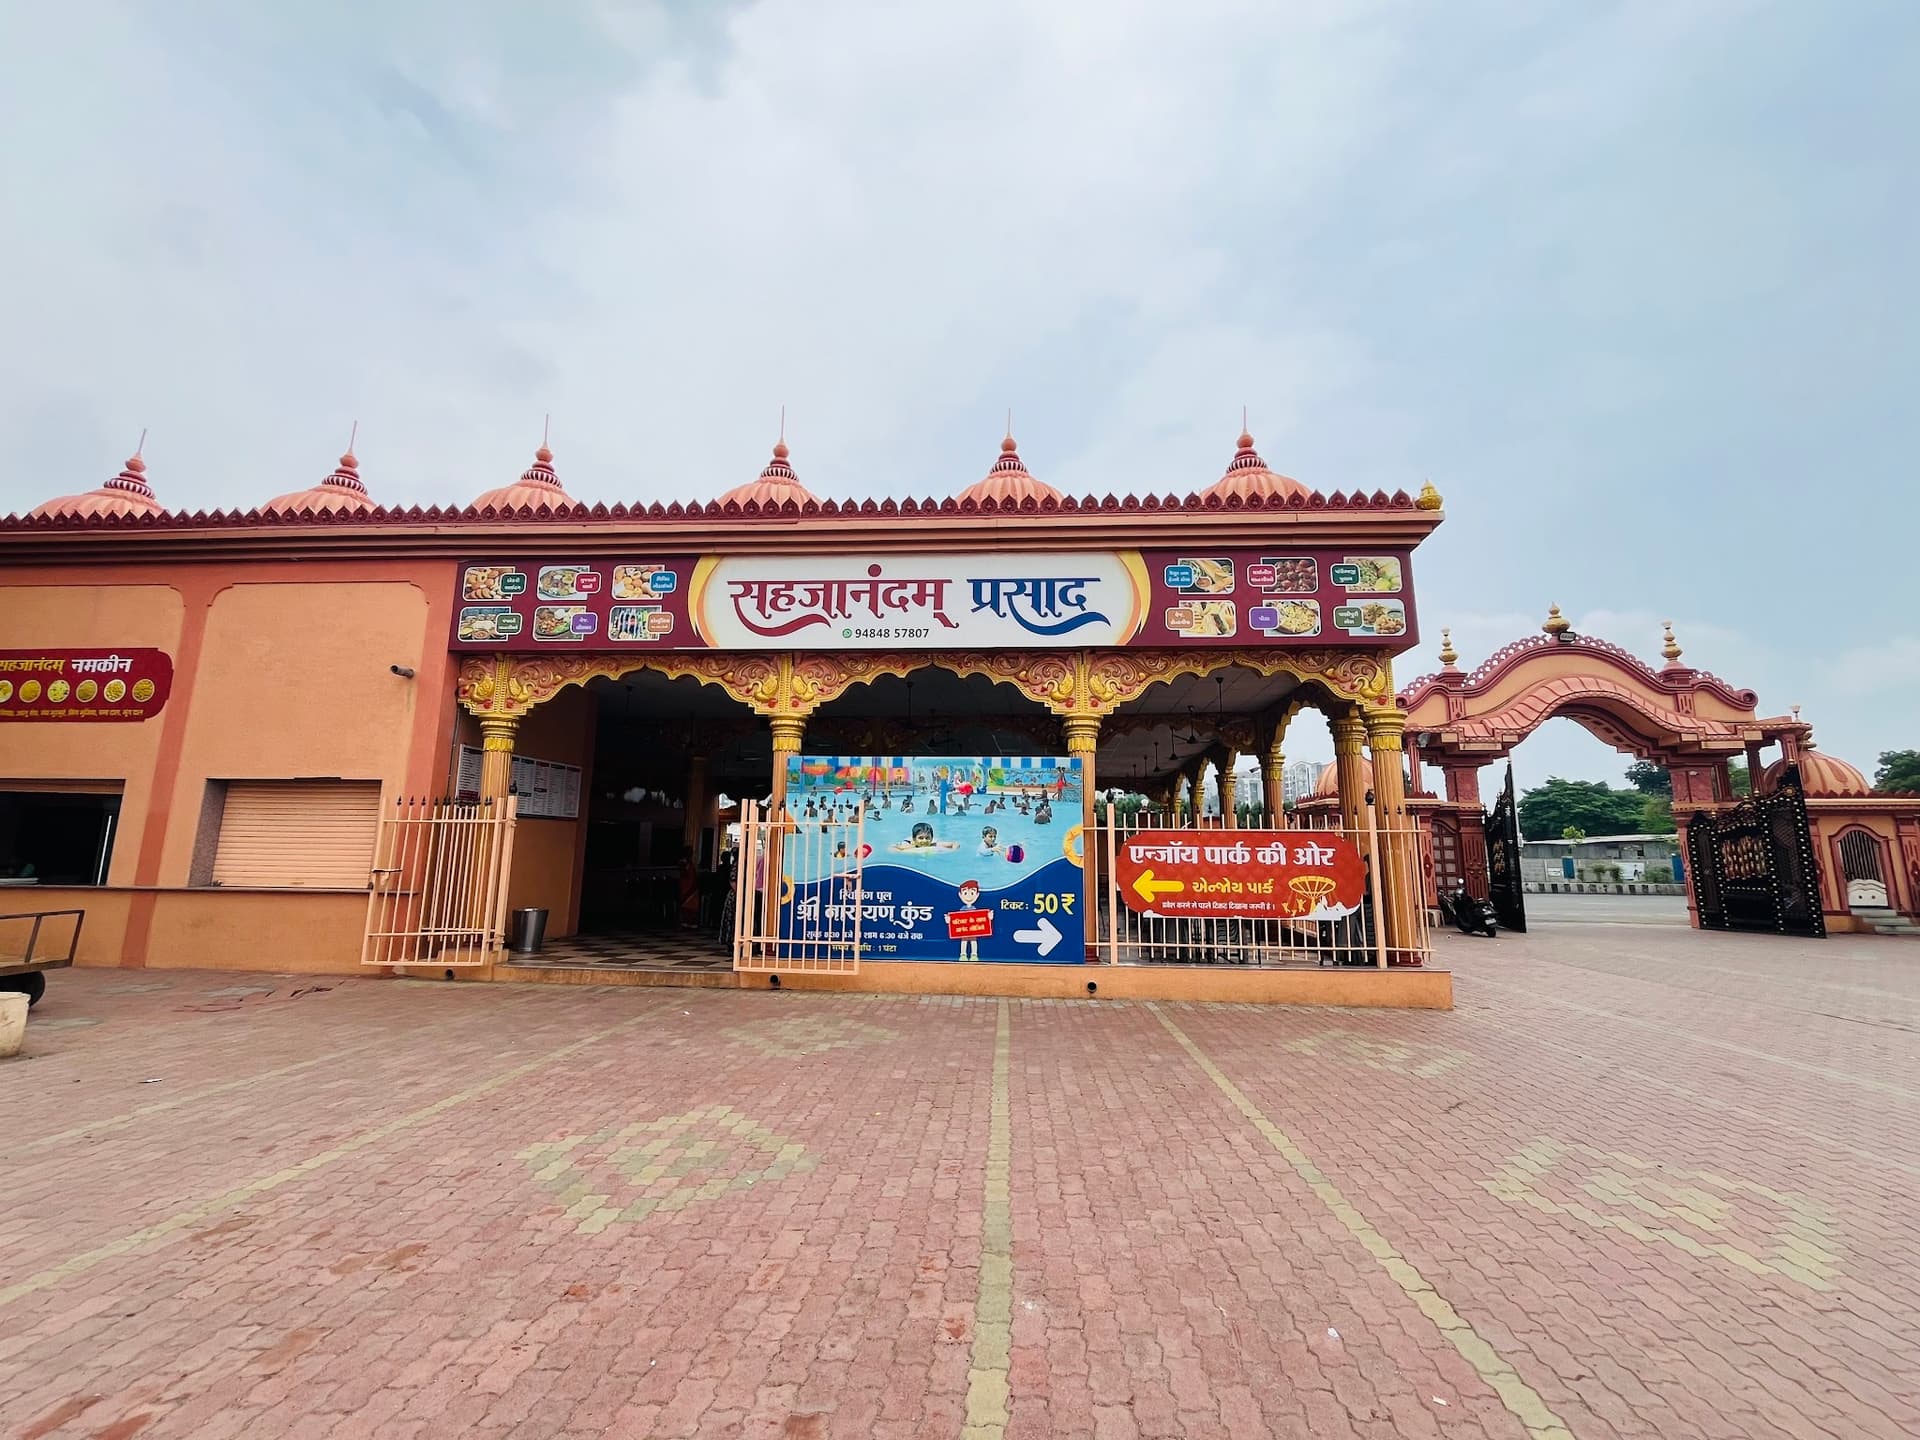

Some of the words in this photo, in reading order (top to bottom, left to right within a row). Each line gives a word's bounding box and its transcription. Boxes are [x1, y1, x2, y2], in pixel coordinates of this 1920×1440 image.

[727, 564, 959, 637] सहजानंदम्
[967, 577, 1111, 636] प्रसाद
[855, 628, 890, 639] 94848
[894, 628, 929, 639] 57807
[72, 654, 134, 673] नमकीन
[1129, 841, 1199, 864] एन्जॉय
[1204, 841, 1251, 865] पार्क
[1255, 841, 1286, 865] की
[1293, 841, 1336, 866] ओर
[1191, 877, 1243, 894] એન્જોય
[1247, 878, 1274, 894] પાર્ક
[877, 891, 892, 903] पूल
[825, 904, 895, 922] नारयण
[893, 901, 934, 929] कुंड
